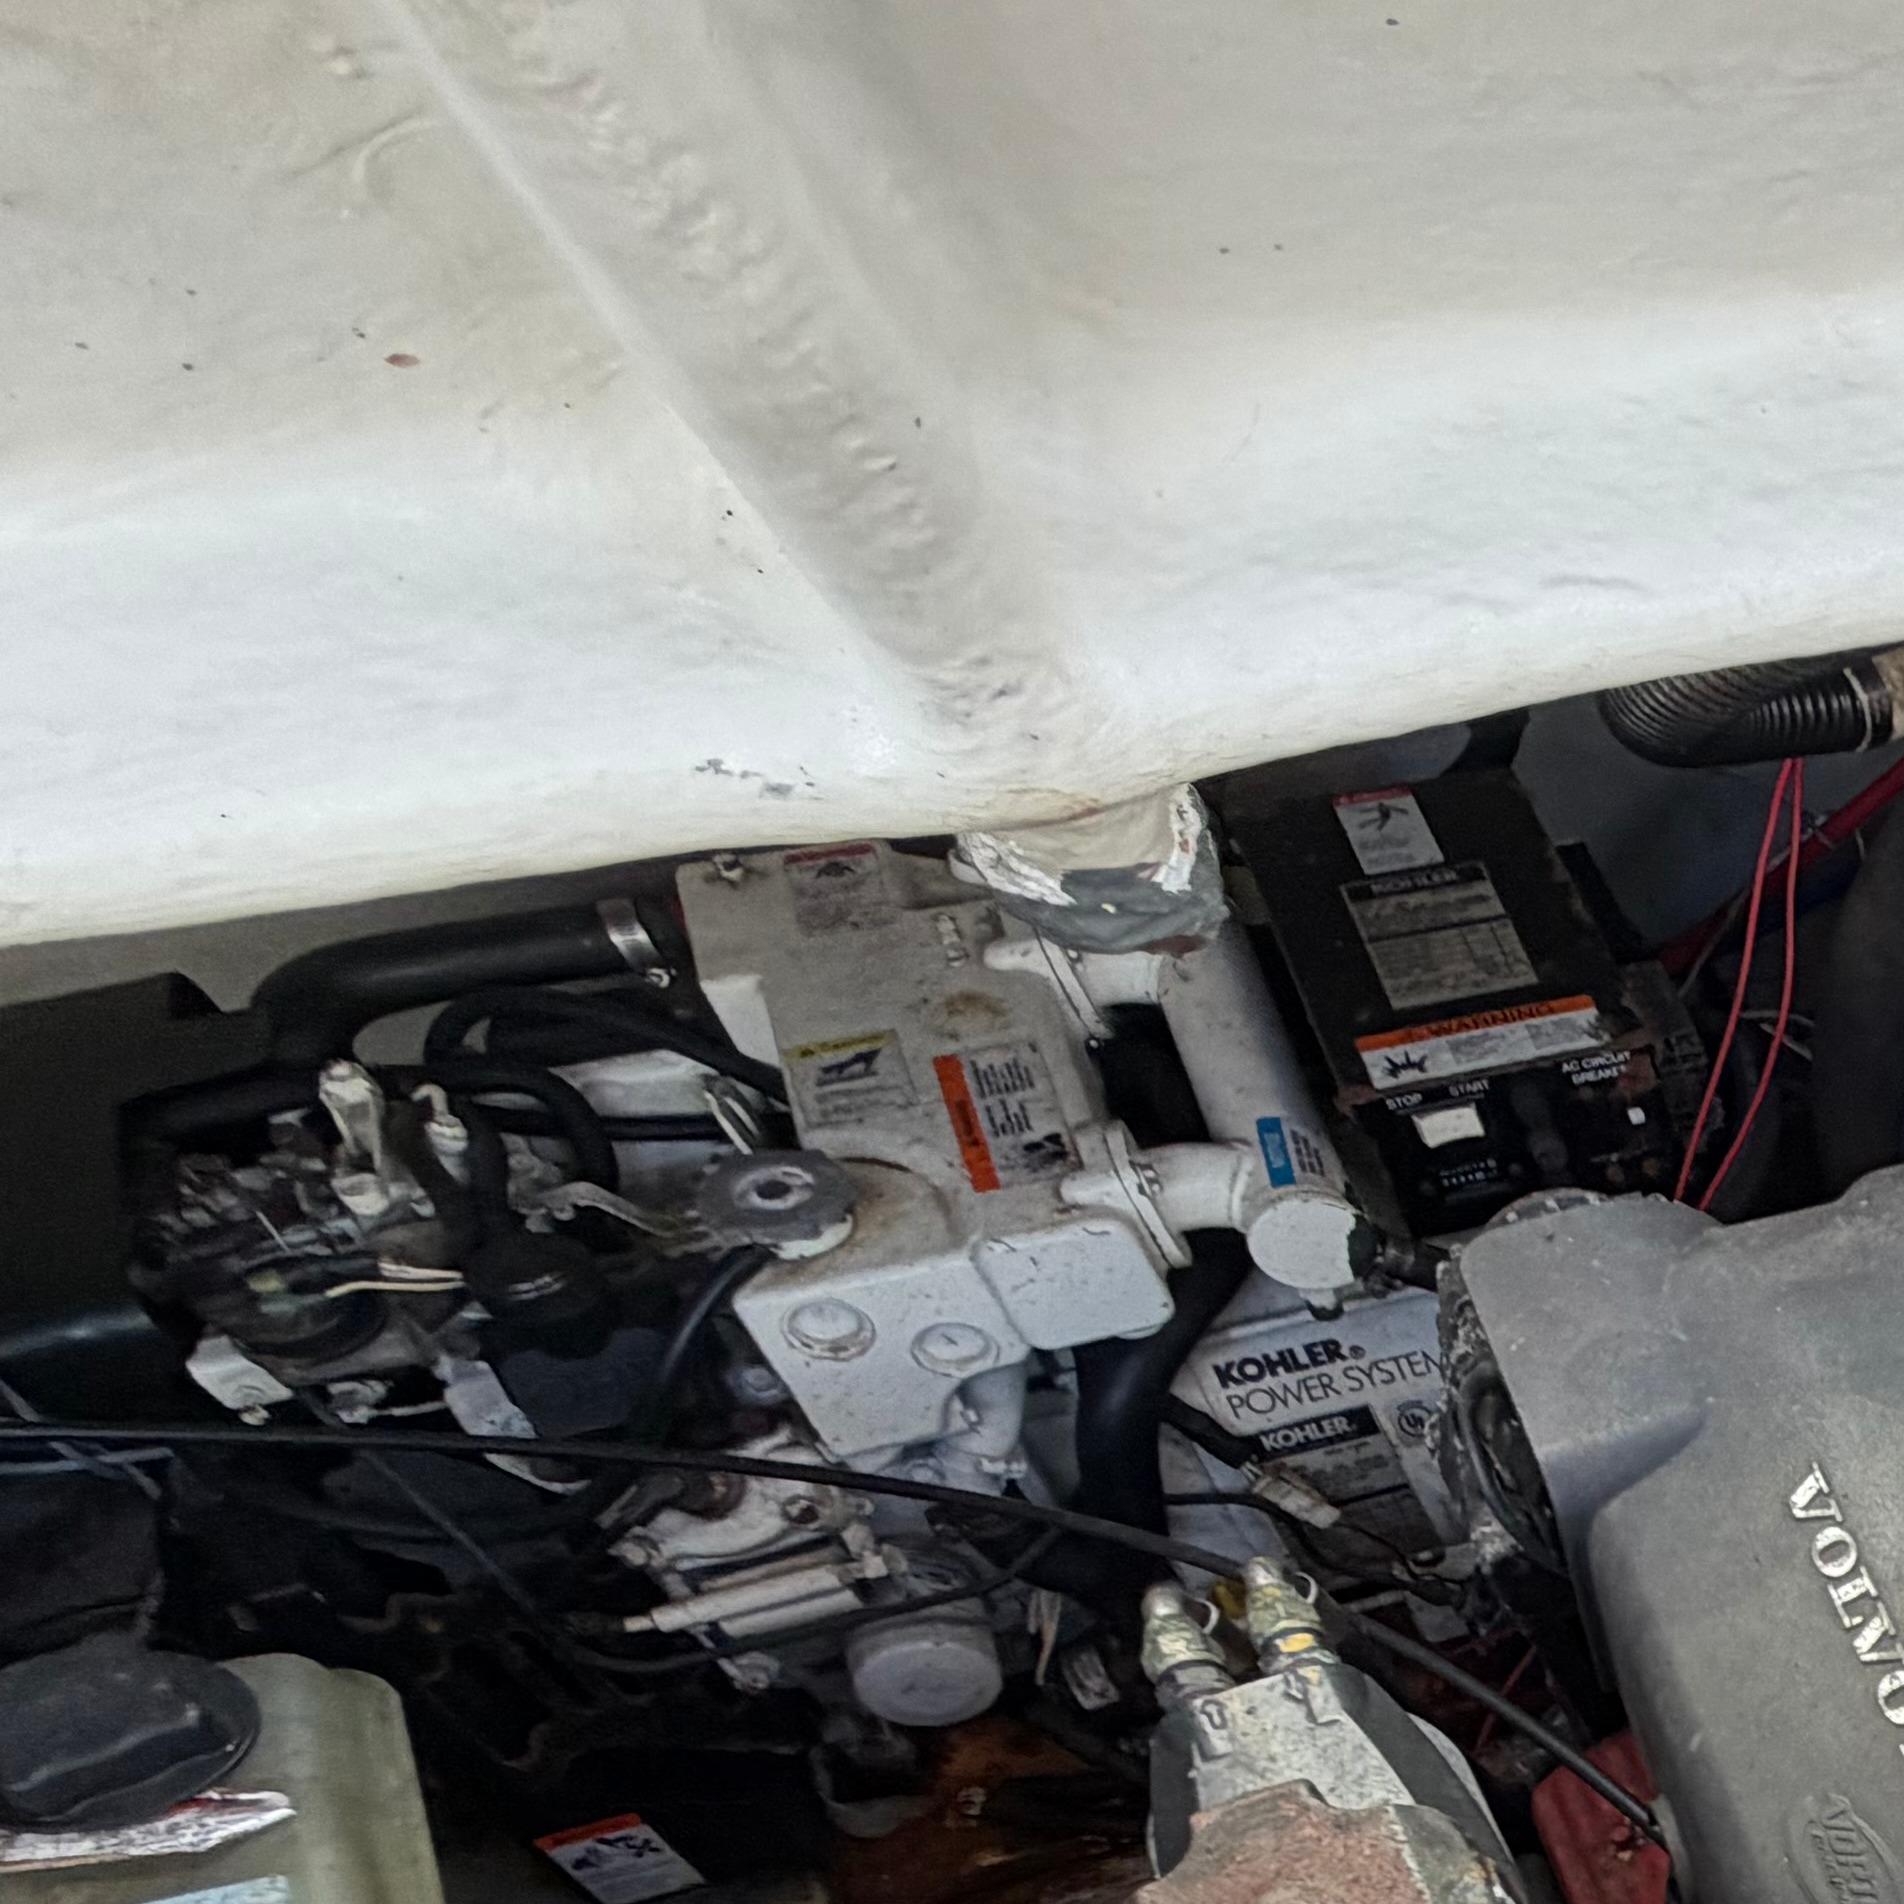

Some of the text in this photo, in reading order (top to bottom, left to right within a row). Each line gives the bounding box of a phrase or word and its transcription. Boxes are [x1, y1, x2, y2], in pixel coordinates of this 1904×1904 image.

[1385, 1092, 1423, 1111] STOP
[1449, 1078, 1490, 1098] START
[1226, 1372, 1341, 1420] POWER
[1259, 1415, 1357, 1451] KOHLER
